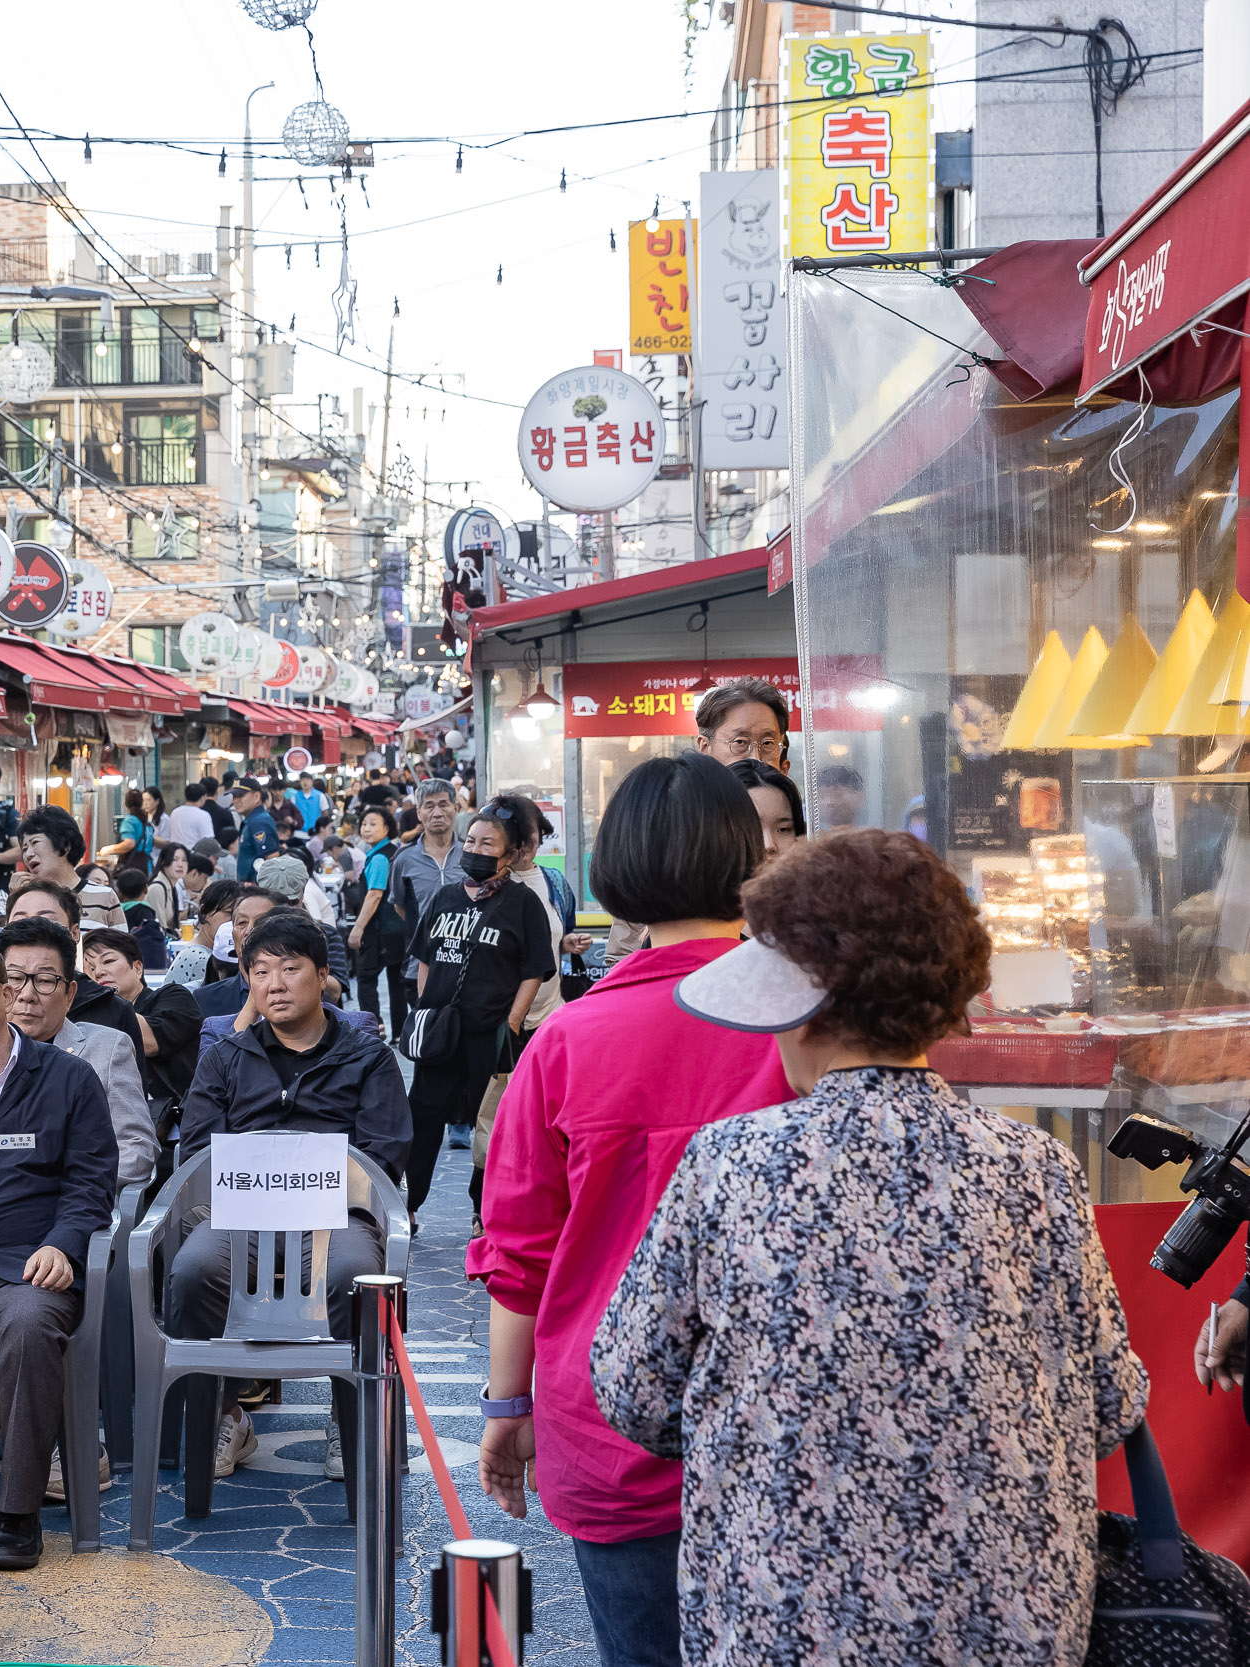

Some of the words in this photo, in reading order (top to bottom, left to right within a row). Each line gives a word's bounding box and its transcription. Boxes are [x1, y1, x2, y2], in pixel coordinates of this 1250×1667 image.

[805, 44, 918, 98] 황금
[823, 109, 896, 248] 축산
[634, 335, 691, 349] 466-02
[546, 375, 630, 405] 화양제일시장
[531, 421, 655, 471] 황금축산
[430, 912, 461, 939] Old
[435, 946, 449, 962] the
[447, 949, 463, 963] Sea
[443, 937, 461, 949] and
[216, 1170, 341, 1191] 서울시의회의원
